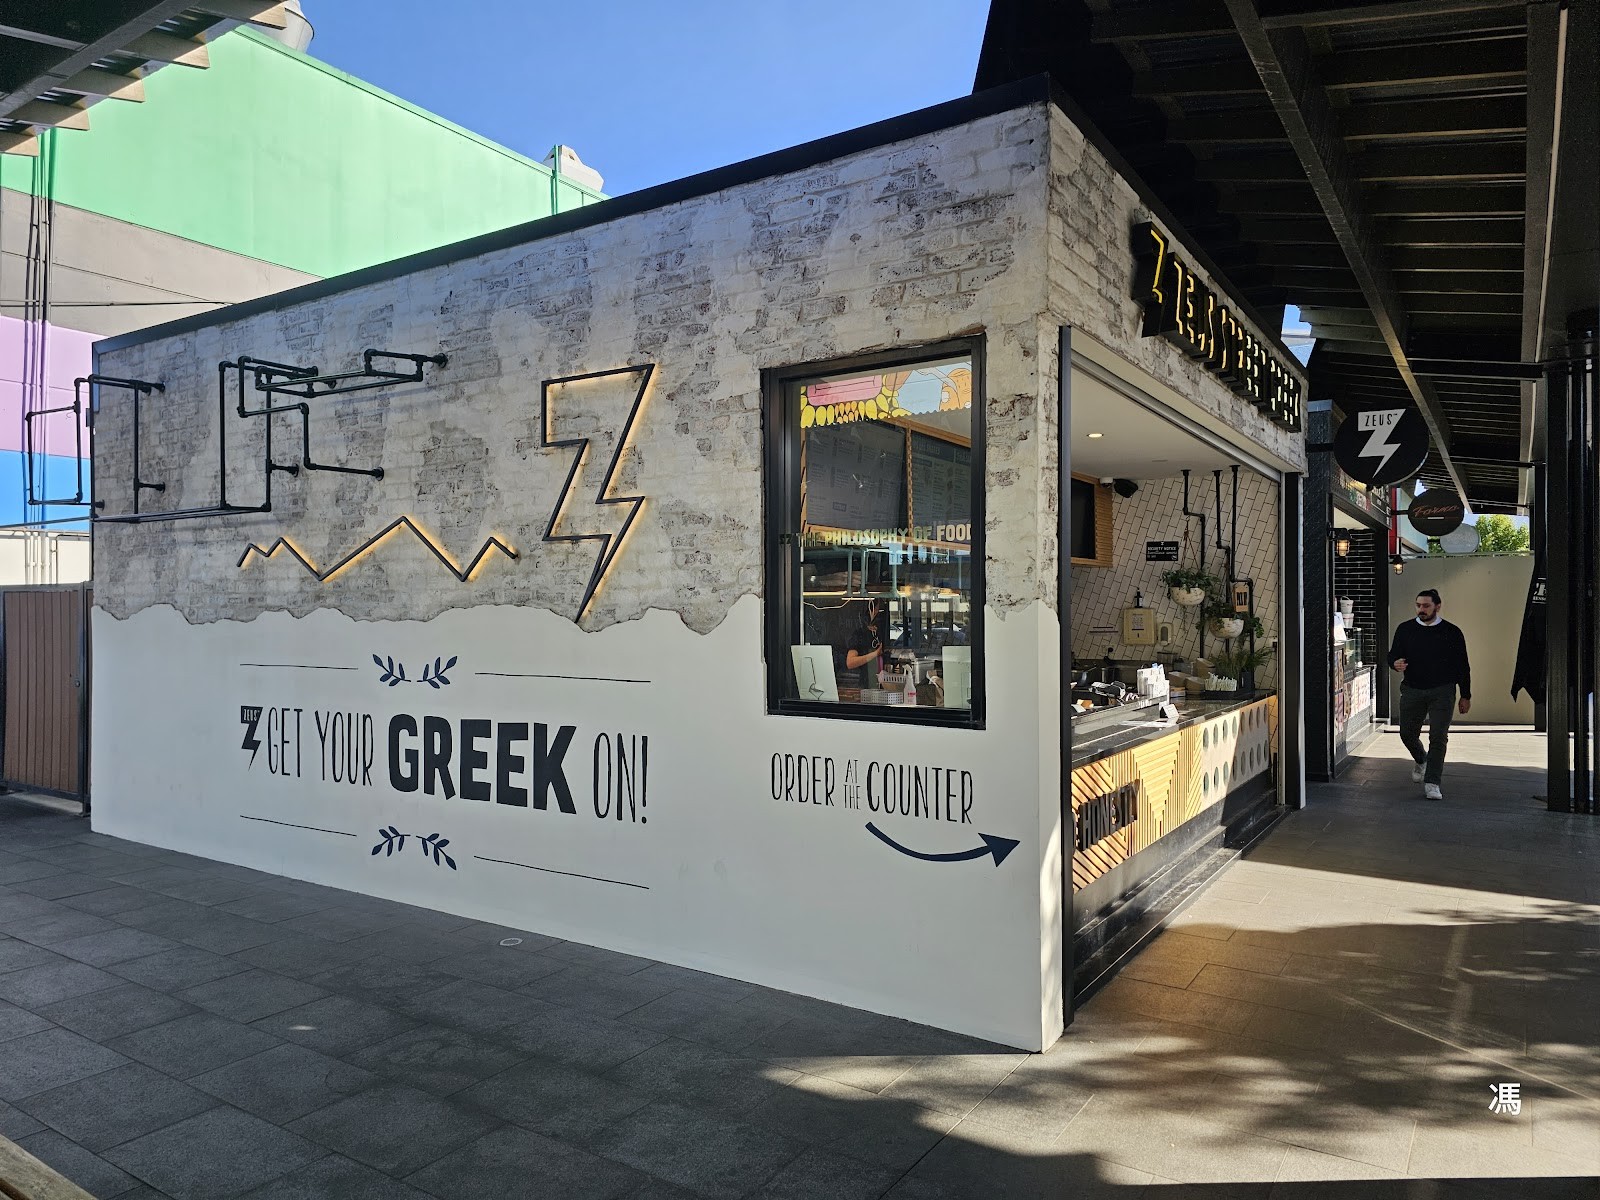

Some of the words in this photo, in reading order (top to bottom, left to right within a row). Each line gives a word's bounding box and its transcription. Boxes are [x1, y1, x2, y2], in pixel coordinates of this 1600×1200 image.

[824, 528, 909, 546] PHILOSOPHY
[913, 525, 932, 543] OF
[267, 706, 303, 778] GET
[314, 710, 373, 787] YOUR
[388, 713, 577, 815] GREEK
[592, 732, 649, 824] ON!
[771, 752, 835, 807] ORDER
[844, 758, 859, 784] AT
[843, 784, 861, 810] THE
[866, 761, 973, 825] COUNTER
